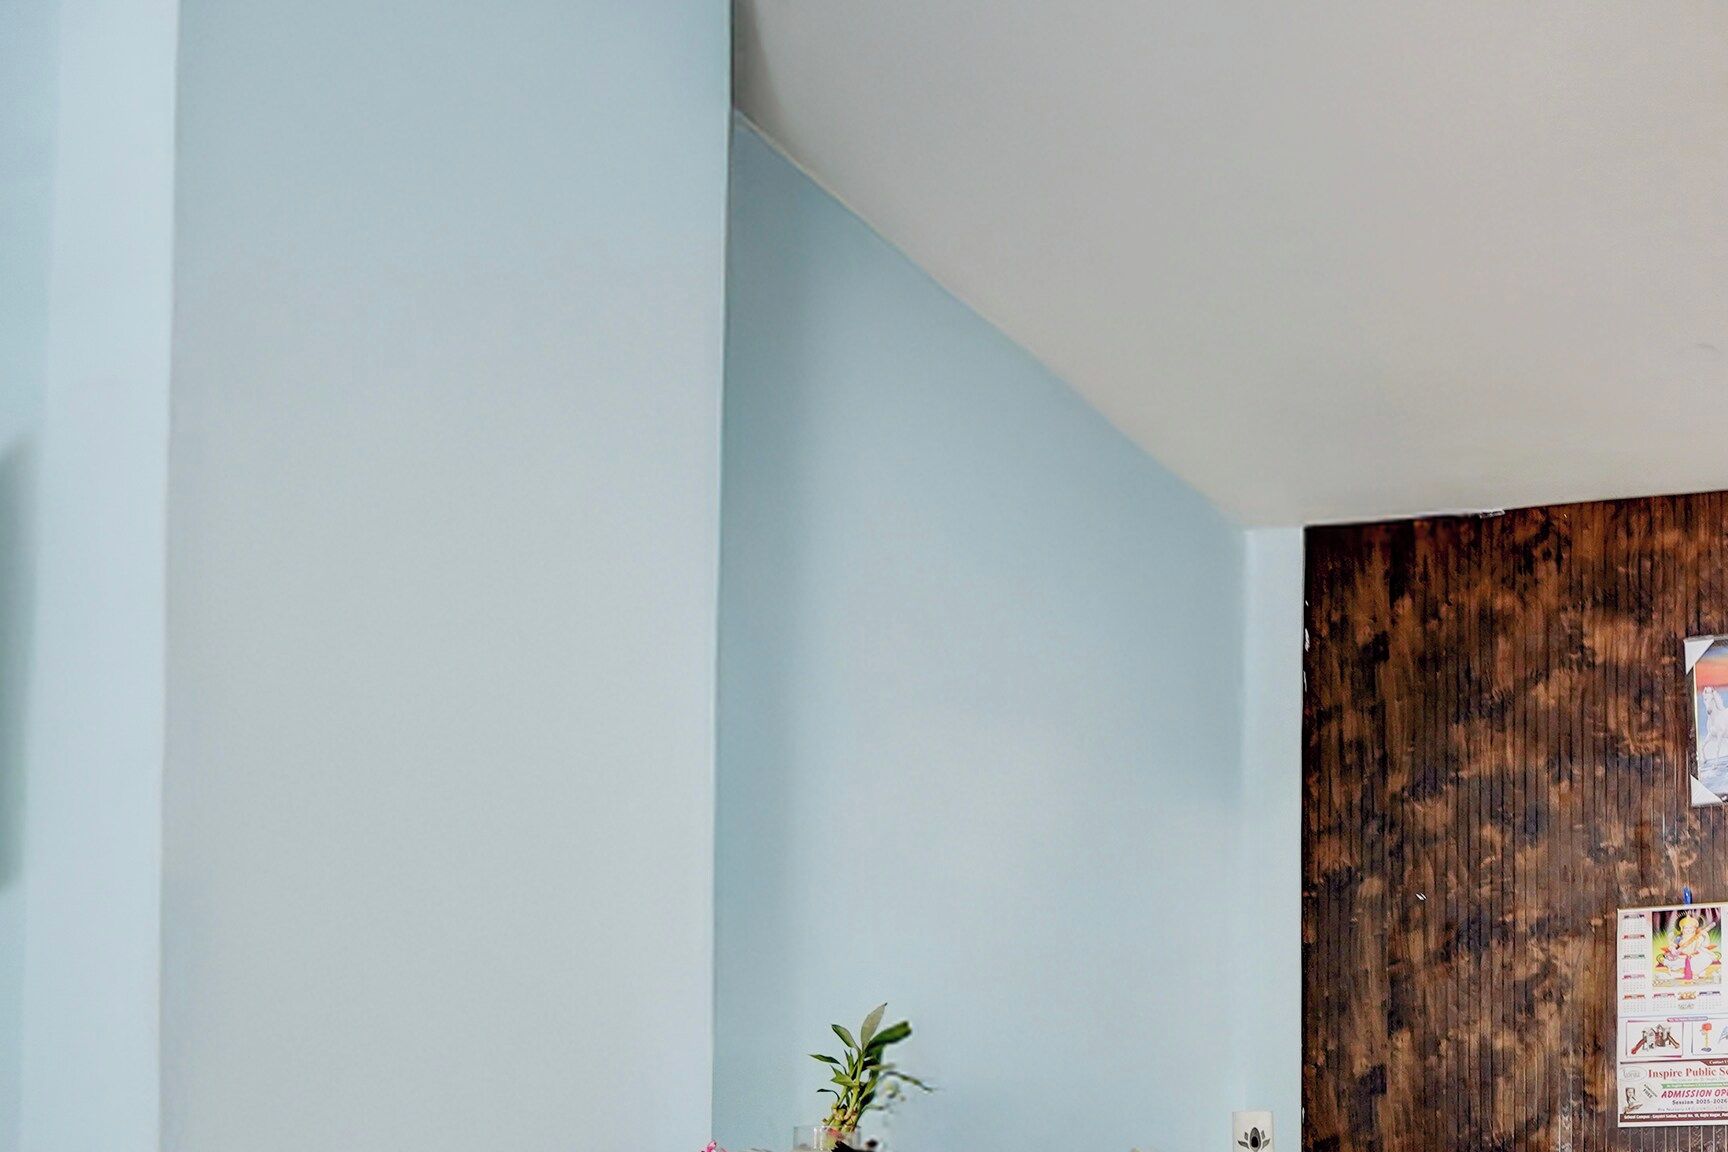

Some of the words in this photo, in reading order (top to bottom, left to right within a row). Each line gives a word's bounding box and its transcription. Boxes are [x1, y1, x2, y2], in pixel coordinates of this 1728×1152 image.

[1648, 1068, 1682, 1080] Inspire
[1686, 1066, 1716, 1077] Public
[1661, 1089, 1712, 1098] ADMISSION
